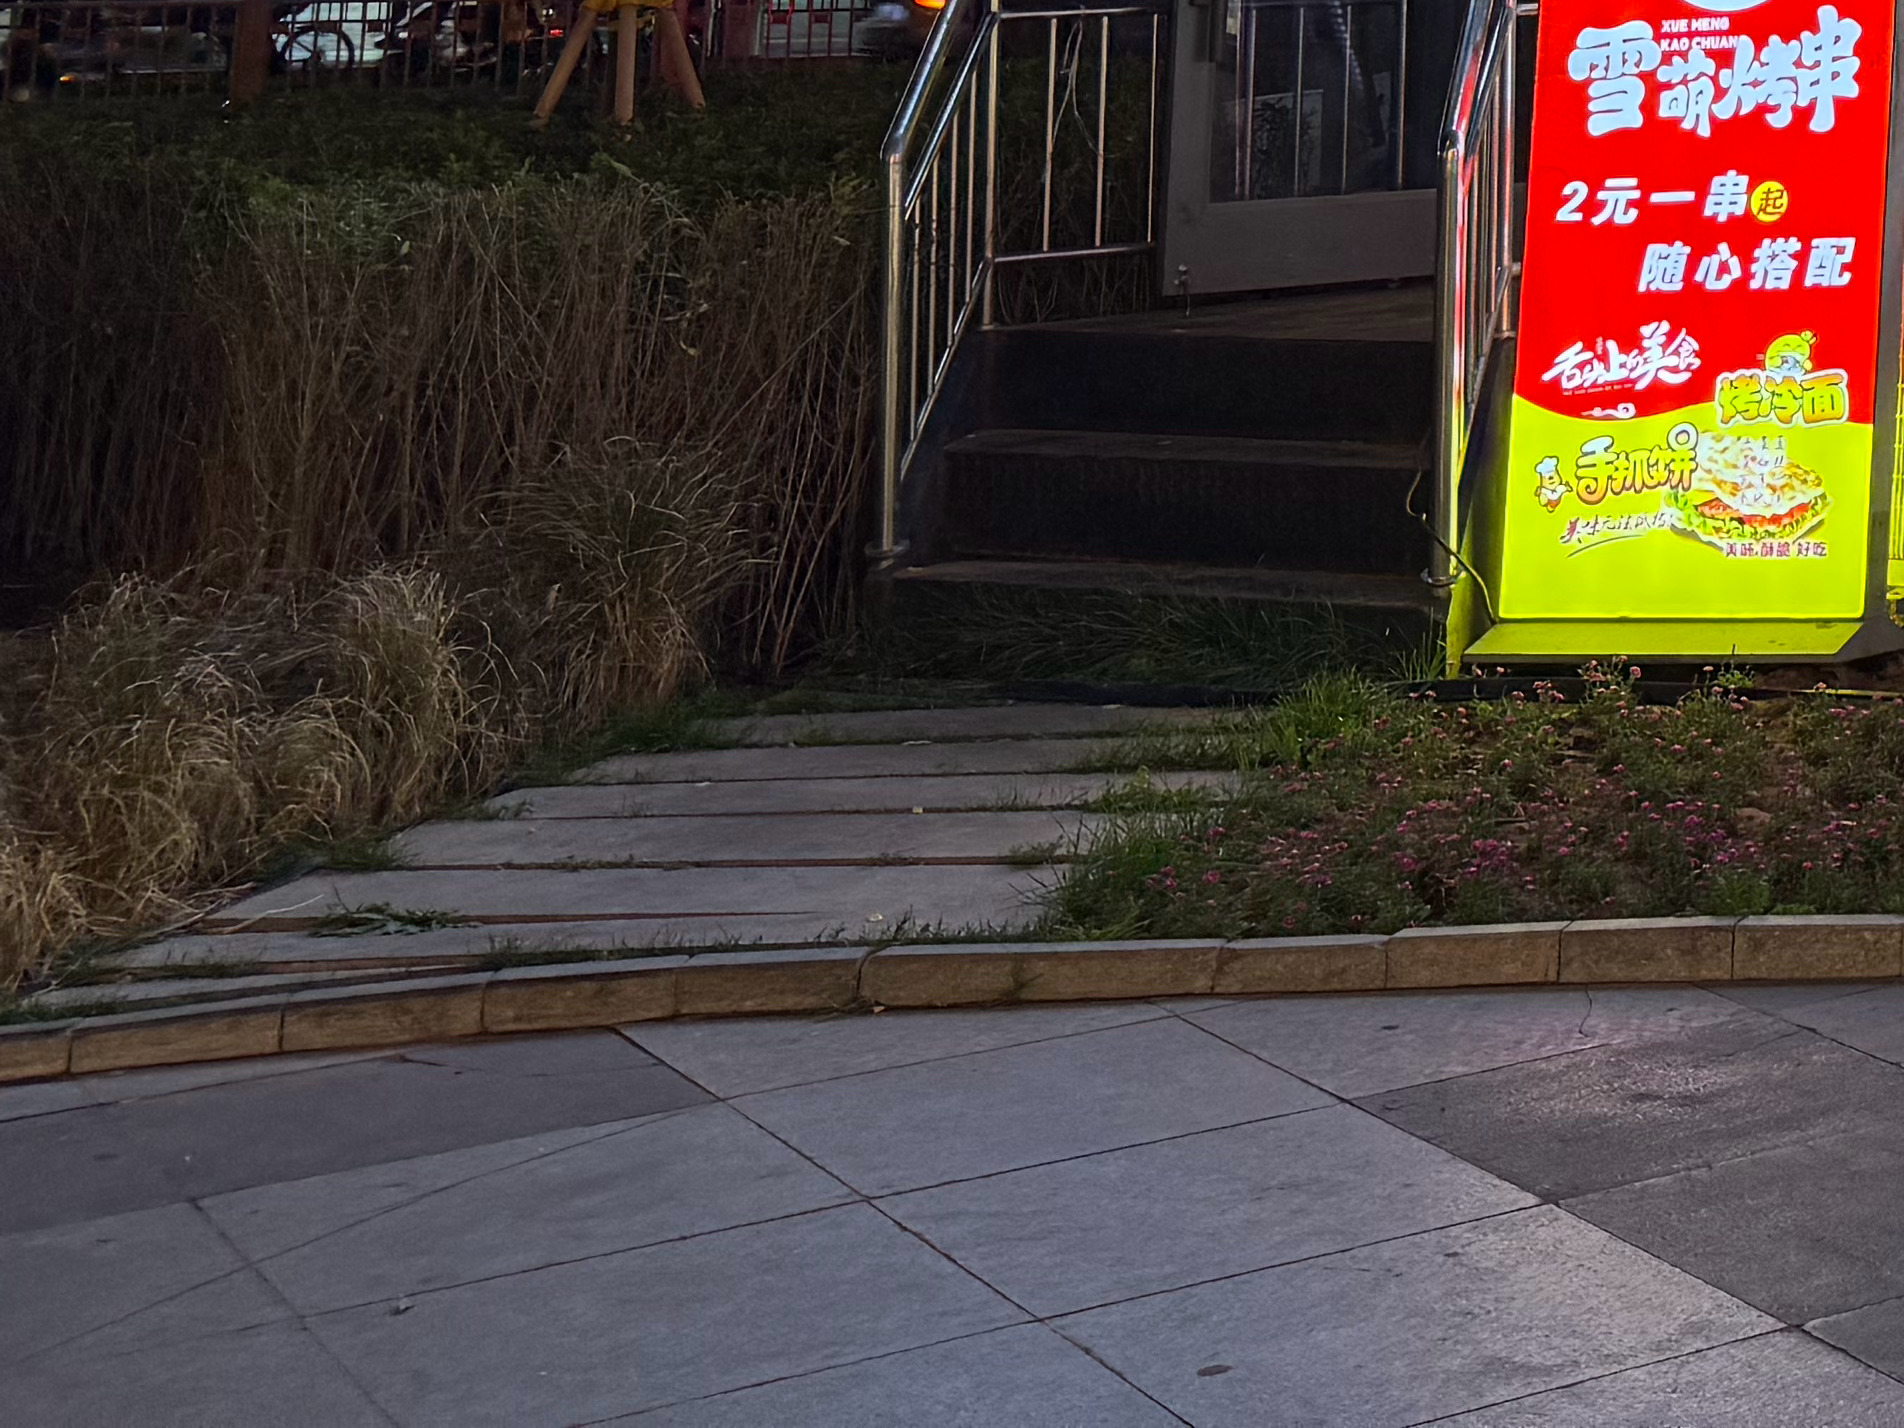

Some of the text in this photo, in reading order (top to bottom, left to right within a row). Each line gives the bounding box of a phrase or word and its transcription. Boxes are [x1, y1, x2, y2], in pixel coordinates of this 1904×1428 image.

[1660, 37, 1690, 52] KAO
[1661, 19, 1689, 33] XUE
[1567, 4, 1862, 138] 雪萌烤串
[1637, 236, 1856, 294] 随心搭配
[1717, 371, 1847, 425] 烤冷面
[1575, 423, 1699, 505] 手抓饼
